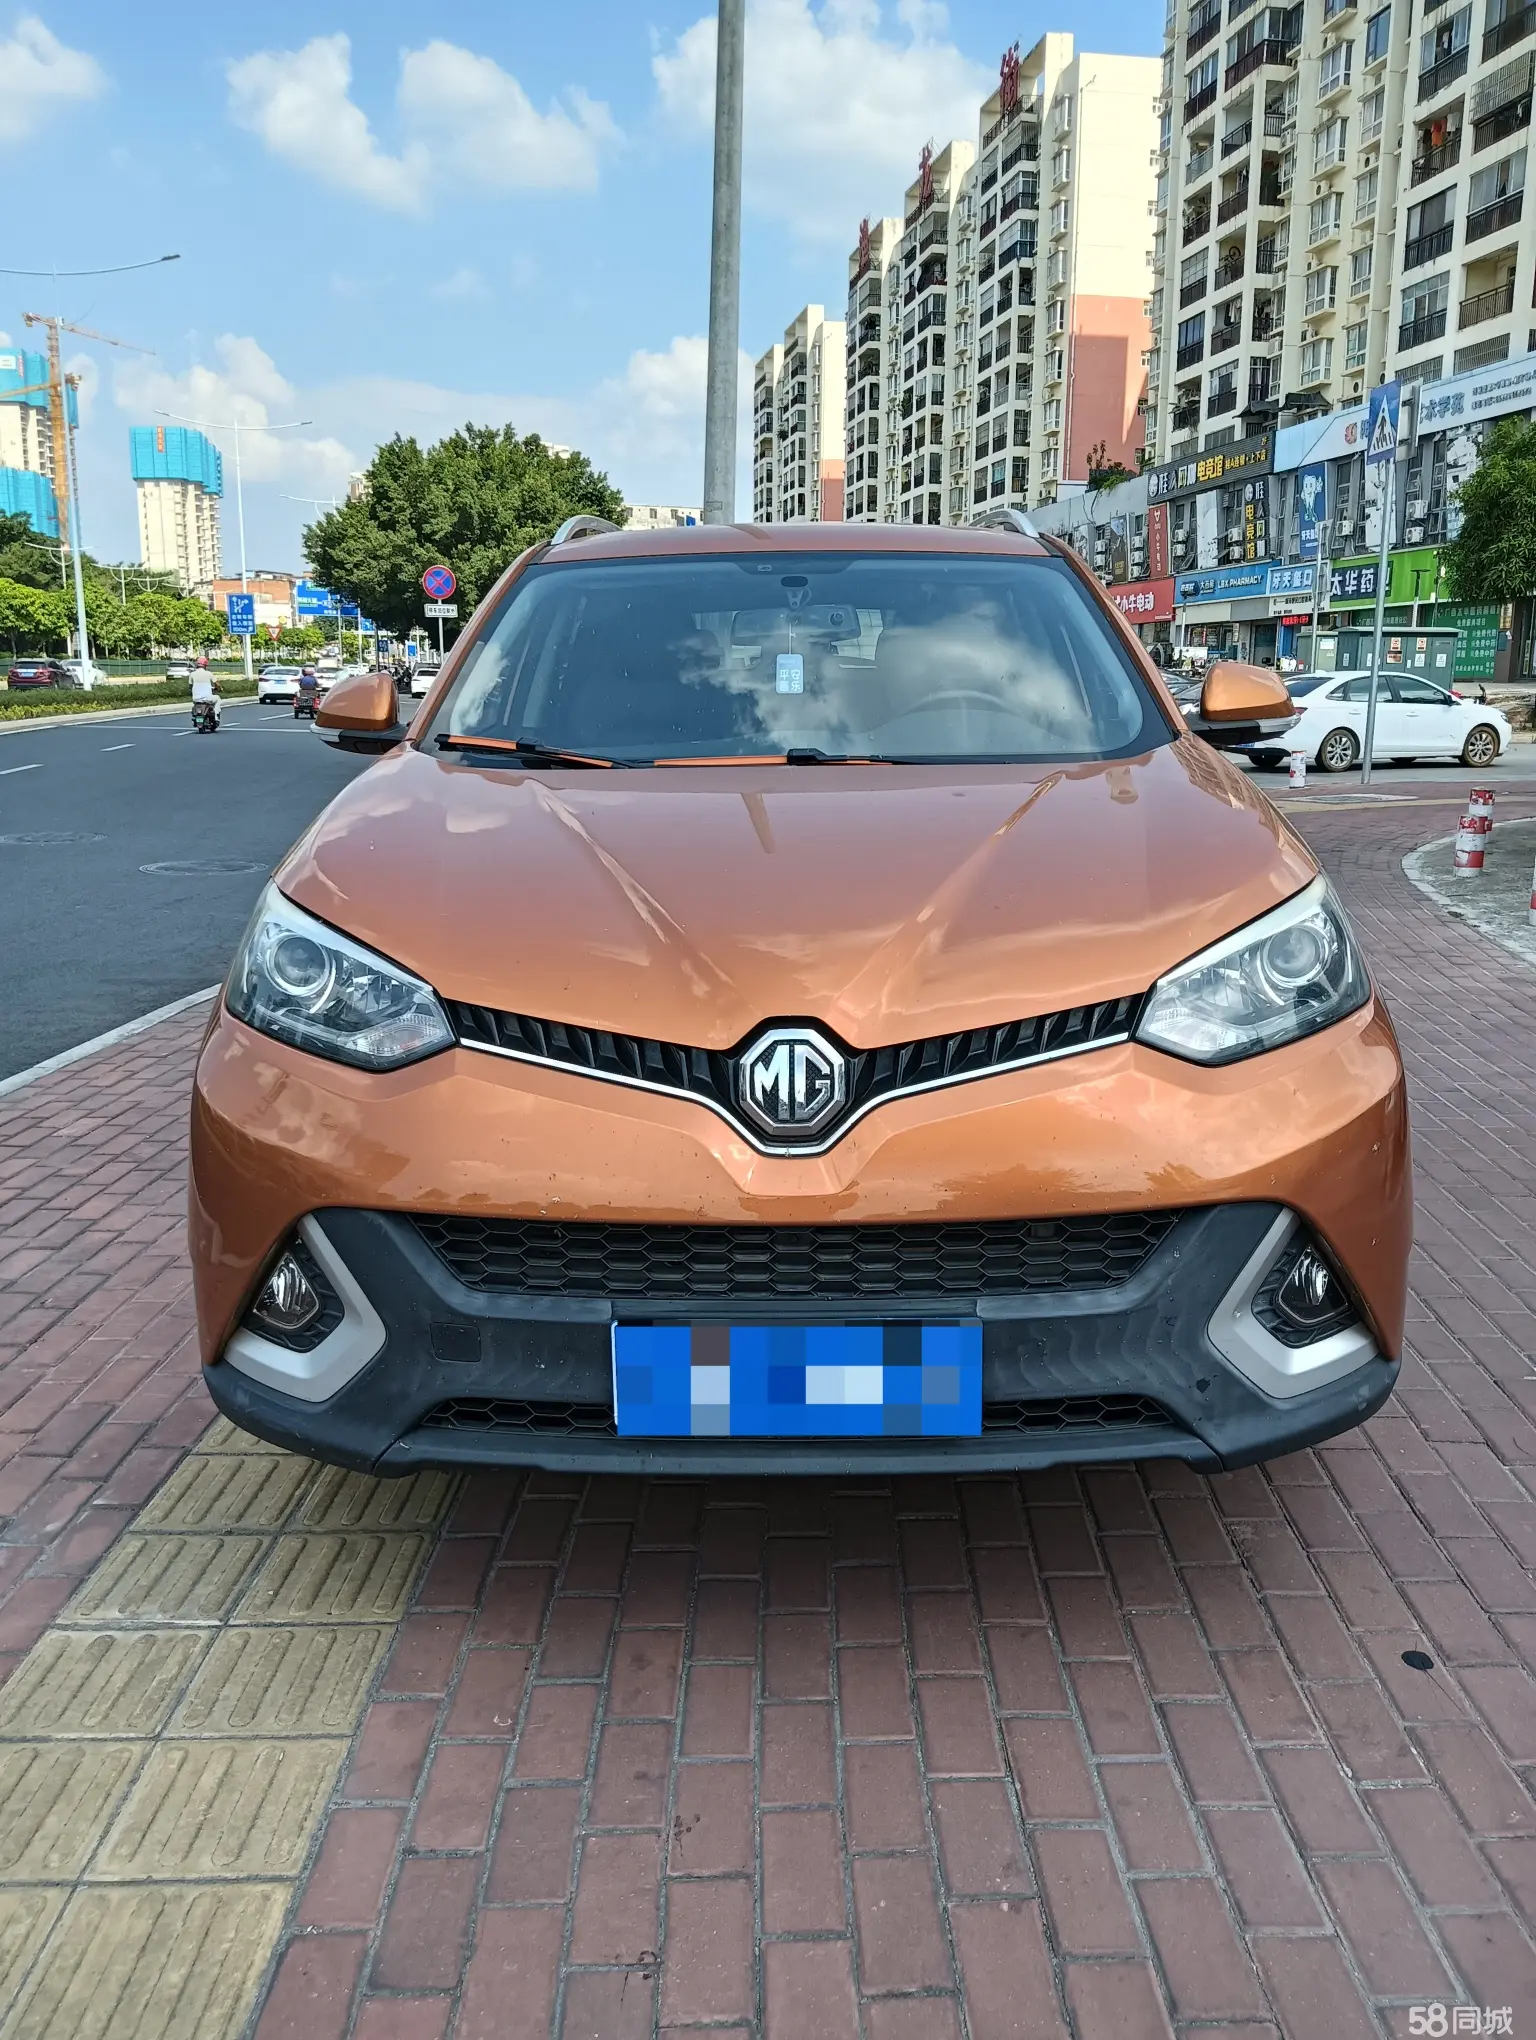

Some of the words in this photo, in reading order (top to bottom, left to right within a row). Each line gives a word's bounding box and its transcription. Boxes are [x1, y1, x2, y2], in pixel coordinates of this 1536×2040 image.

[1245, 504, 1255, 560] 电竞馆
[1217, 579, 1229, 589] LBX
[1229, 575, 1262, 588] PHARMACY
[754, 1044, 831, 1121] MG
